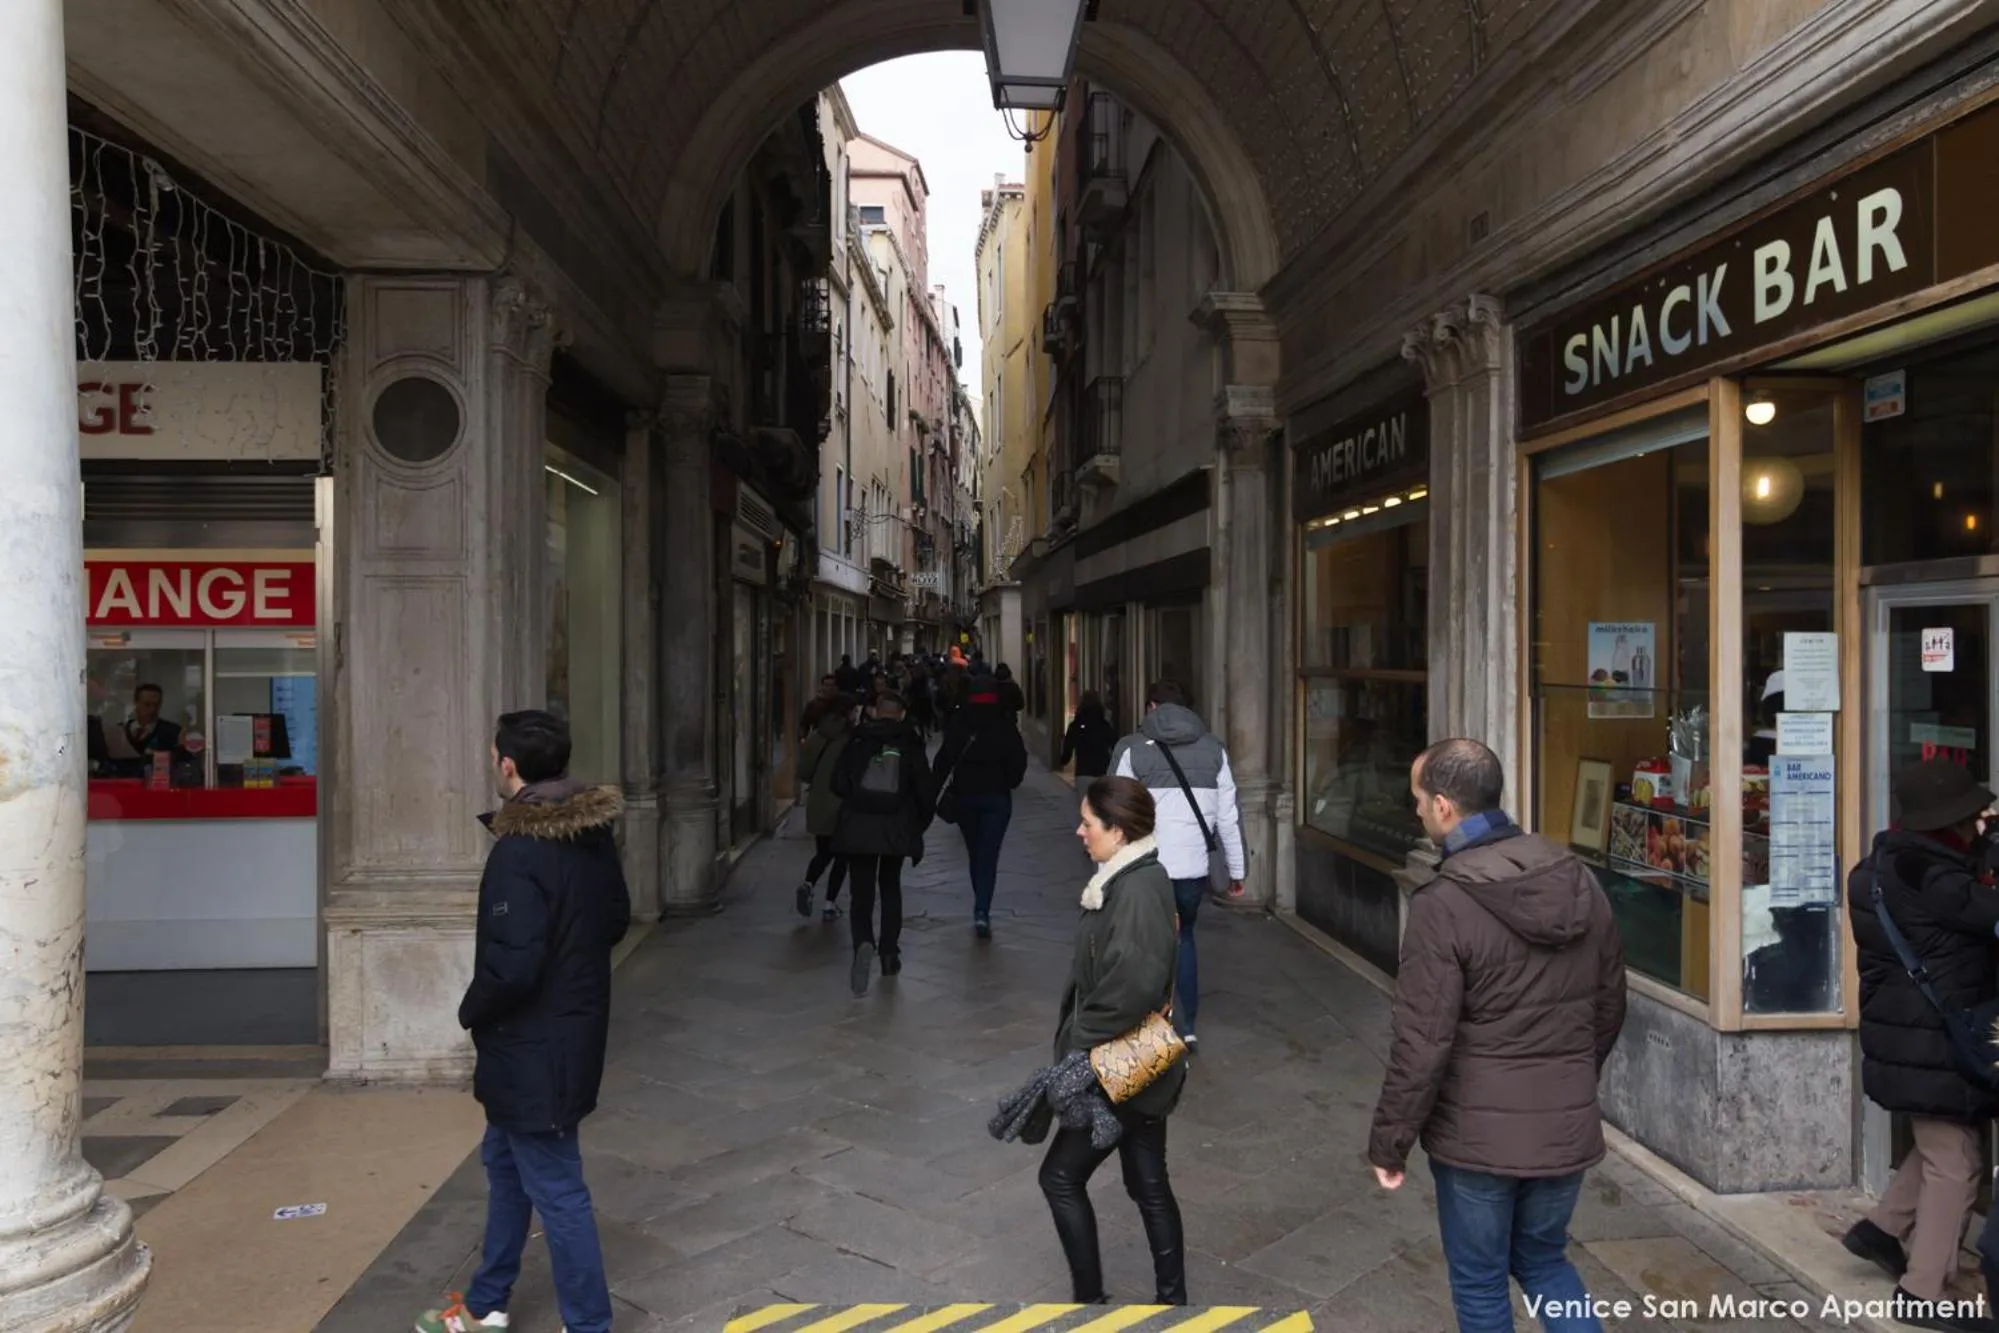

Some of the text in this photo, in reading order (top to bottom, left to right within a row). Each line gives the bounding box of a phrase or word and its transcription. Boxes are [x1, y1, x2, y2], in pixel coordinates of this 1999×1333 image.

[1563, 187, 1908, 395] SNACK BAR
[1310, 411, 1406, 492] AMERICAN
[1787, 772, 1831, 780] AMERICANO
